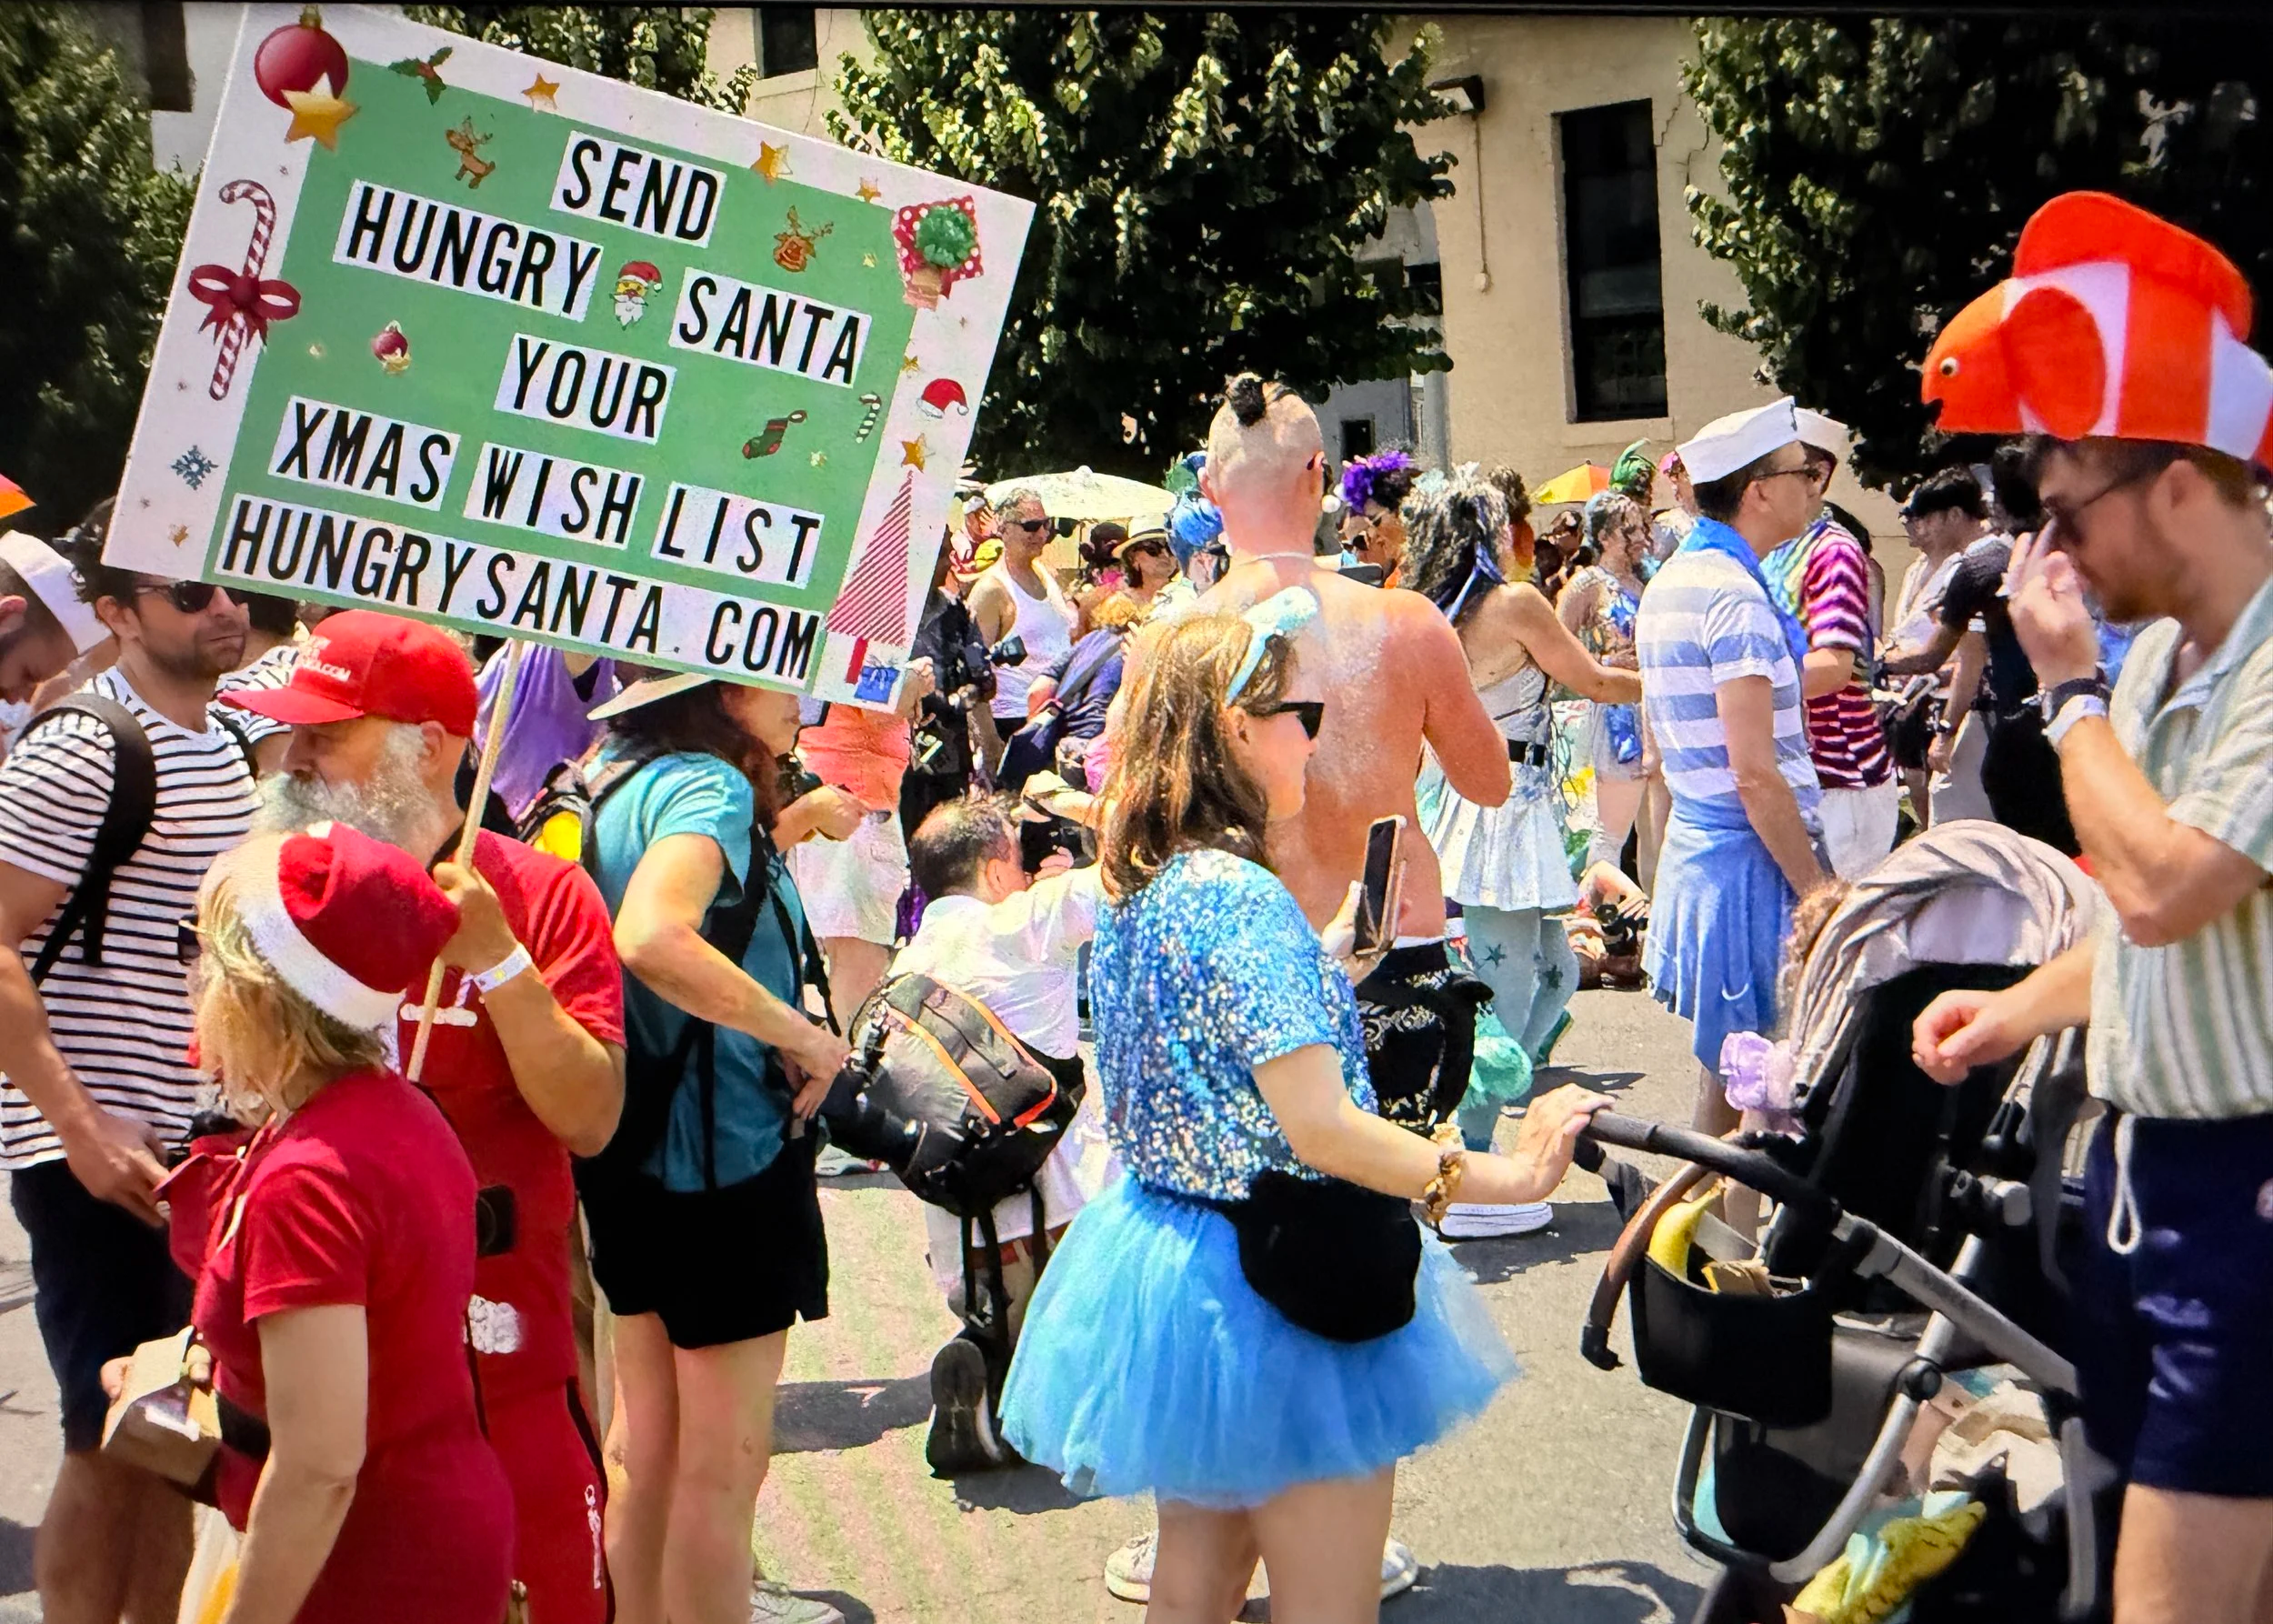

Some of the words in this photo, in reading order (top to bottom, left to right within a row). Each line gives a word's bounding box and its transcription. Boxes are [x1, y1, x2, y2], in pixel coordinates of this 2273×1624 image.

[564, 140, 716, 240] SEND
[347, 186, 600, 316] HUNGRY
[680, 277, 862, 385] SANTA
[515, 338, 667, 437] YOUR
[276, 403, 450, 503] XMAS
[484, 448, 639, 545] WISH
[660, 489, 821, 581] LIST
